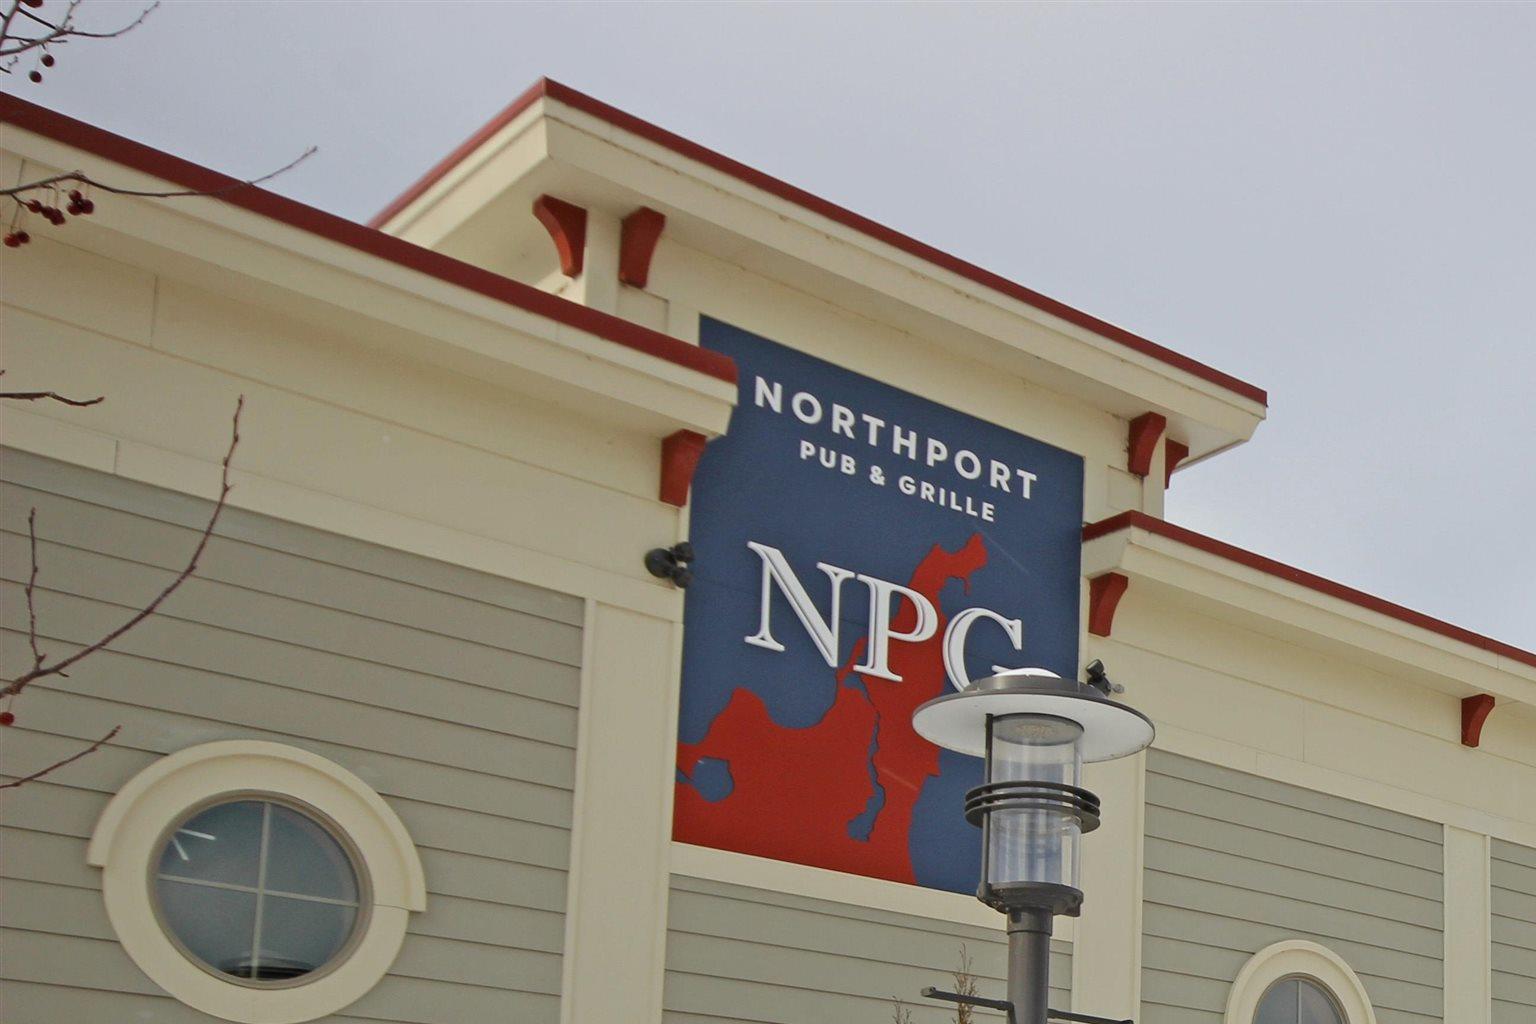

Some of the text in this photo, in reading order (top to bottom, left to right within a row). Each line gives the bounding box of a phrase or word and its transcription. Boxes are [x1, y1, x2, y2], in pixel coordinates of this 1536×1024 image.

[754, 376, 1037, 500] NORTHPORT
[800, 440, 995, 522] PUB & GRILLE
[745, 542, 1022, 692] NPG
